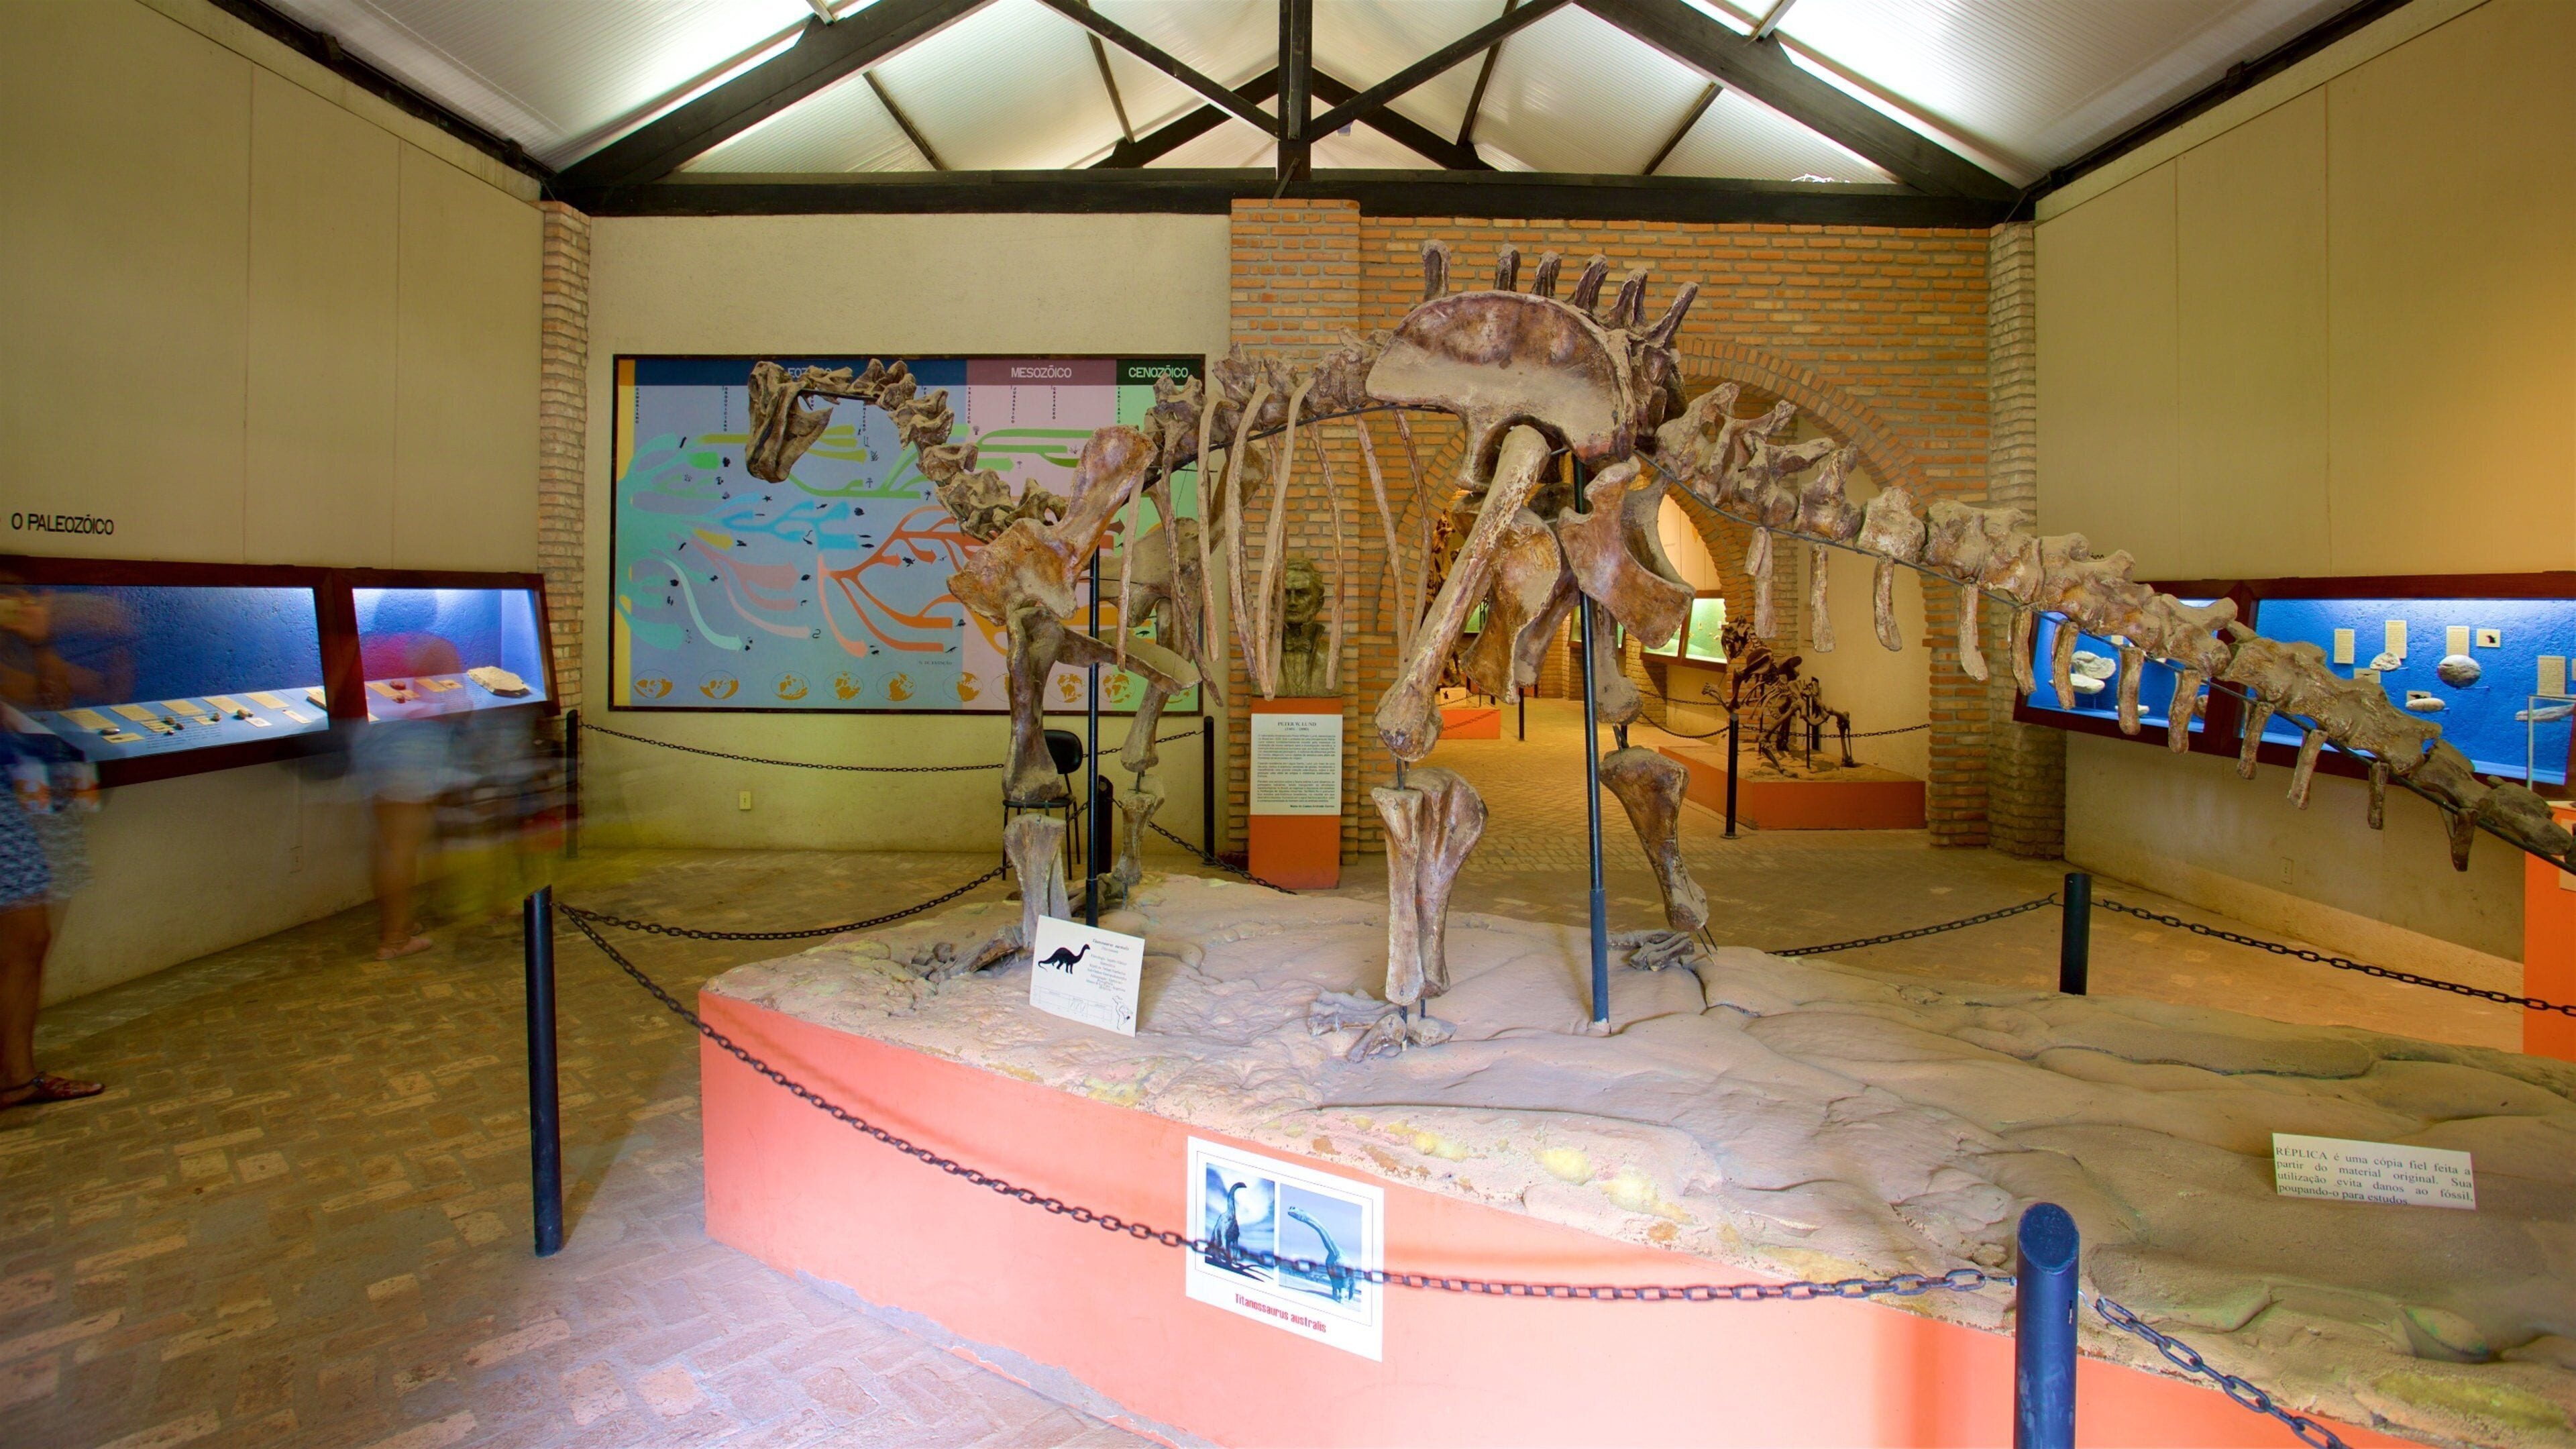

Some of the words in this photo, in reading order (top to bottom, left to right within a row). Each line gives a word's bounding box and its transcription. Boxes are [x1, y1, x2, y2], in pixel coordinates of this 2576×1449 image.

[11, 513, 23, 530] O
[28, 513, 114, 535] PALEOZÓICO
[2275, 1146, 2328, 1160] RÉPLICA
[2346, 1156, 2368, 1164] uma
[2373, 1158, 2403, 1169] cópia
[2410, 1160, 2427, 1170] fiel
[2434, 1163, 2458, 1174] feita
[2277, 1161, 2304, 1169] partir
[2314, 1163, 2327, 1171] do
[2339, 1167, 2381, 1177] material
[2394, 1172, 2439, 1185] original.
[2451, 1177, 2473, 1188] Sua
[2277, 1172, 2326, 1183] utilização
[2337, 1178, 2362, 1187] evita
[2373, 1181, 2404, 1192] danos
[2279, 1185, 2339, 1197] poupando-o
[2342, 1191, 2365, 1199] para
[1235, 1293, 1288, 1320] Titanossaurus
[1291, 1314, 1326, 1333] australis
